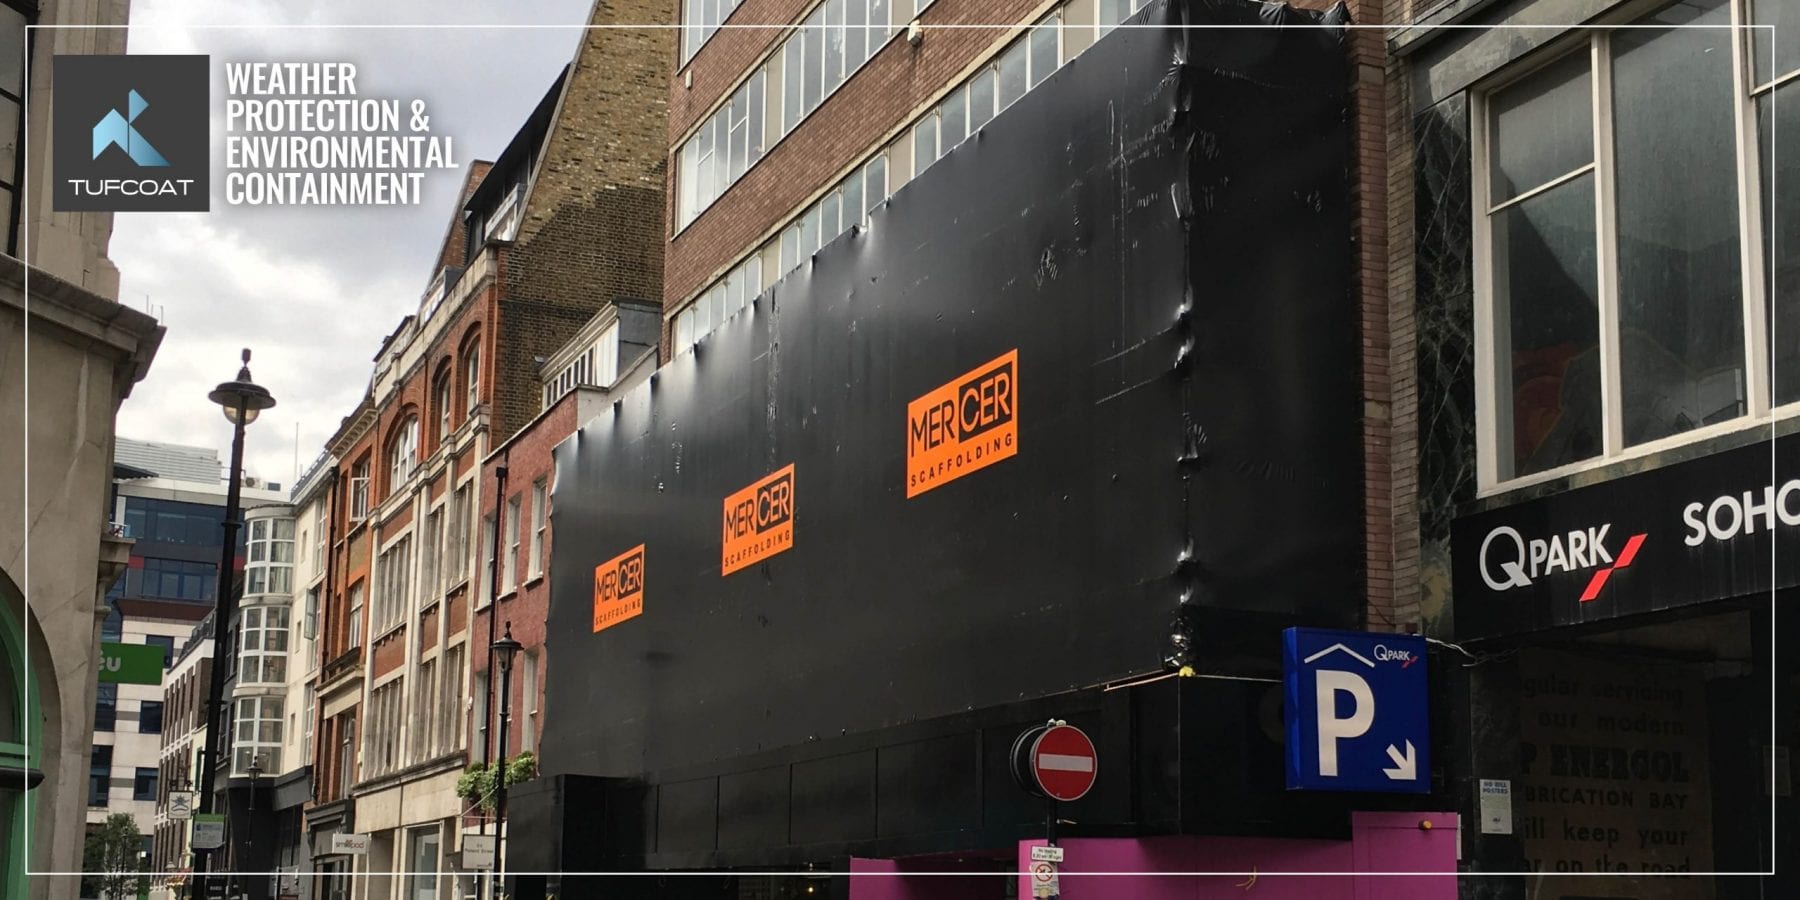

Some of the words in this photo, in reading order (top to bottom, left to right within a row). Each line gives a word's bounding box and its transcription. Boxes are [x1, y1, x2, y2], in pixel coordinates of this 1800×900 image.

[911, 372, 1011, 458] MERCER
[911, 433, 1013, 488] SCAFFOLDING
[725, 480, 790, 544] MERCER
[1683, 479, 1800, 547] SOHO
[724, 529, 790, 568] SCAFFOLDING
[596, 556, 641, 605] MERCER
[595, 598, 641, 626] SCAFFOLDING
[1316, 669, 1375, 777] P
[1537, 710, 1577, 729] our
[1597, 710, 1685, 737] modern
[1551, 743, 1689, 783] ENERGOL
[1649, 791, 1689, 809] BAY
[1563, 818, 1619, 848] keep
[1637, 826, 1689, 849] your
[1556, 859, 1583, 873] on
[1641, 856, 1690, 878] road
